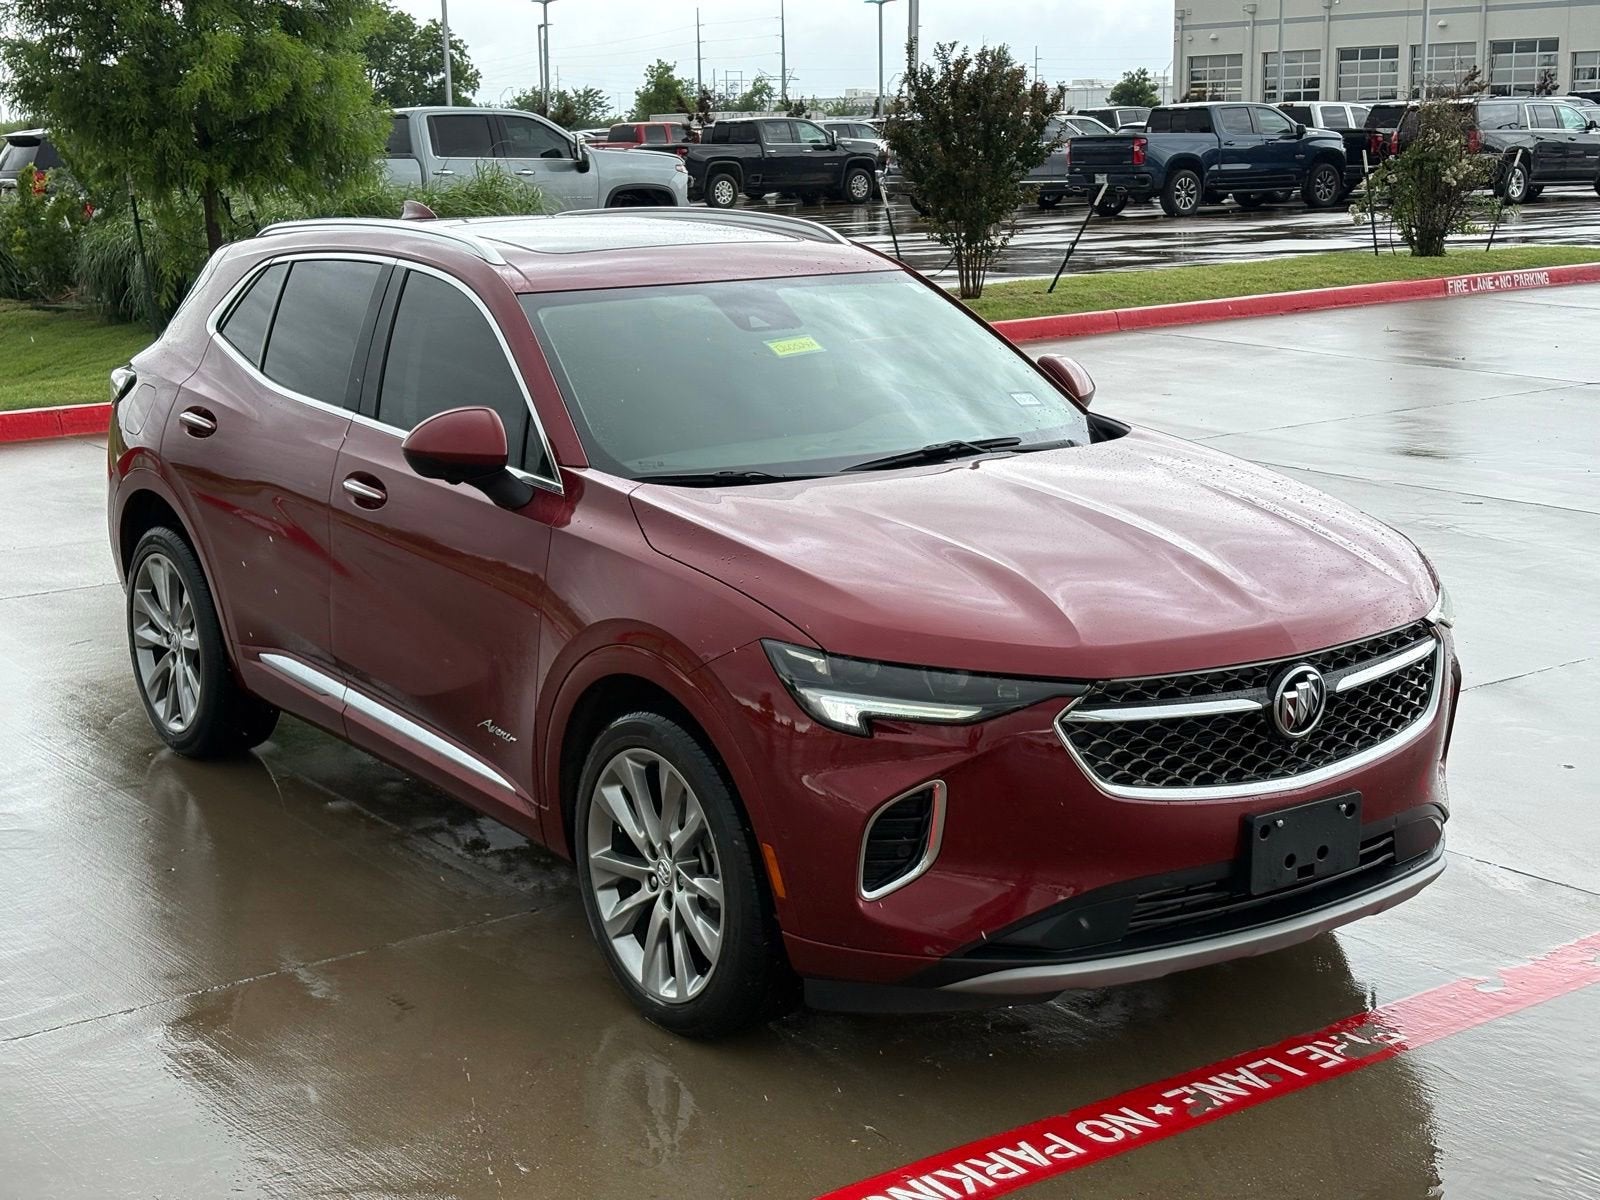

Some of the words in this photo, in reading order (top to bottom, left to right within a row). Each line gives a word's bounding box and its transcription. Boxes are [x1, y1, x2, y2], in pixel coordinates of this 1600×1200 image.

[1447, 279, 1469, 294] FIRE
[1470, 276, 1495, 292] LANE
[1500, 275, 1512, 289] NO
[1514, 271, 1550, 287] PARKING
[1075, 1106, 1162, 1143] NO
[861, 1132, 1088, 1200] PARKIN
